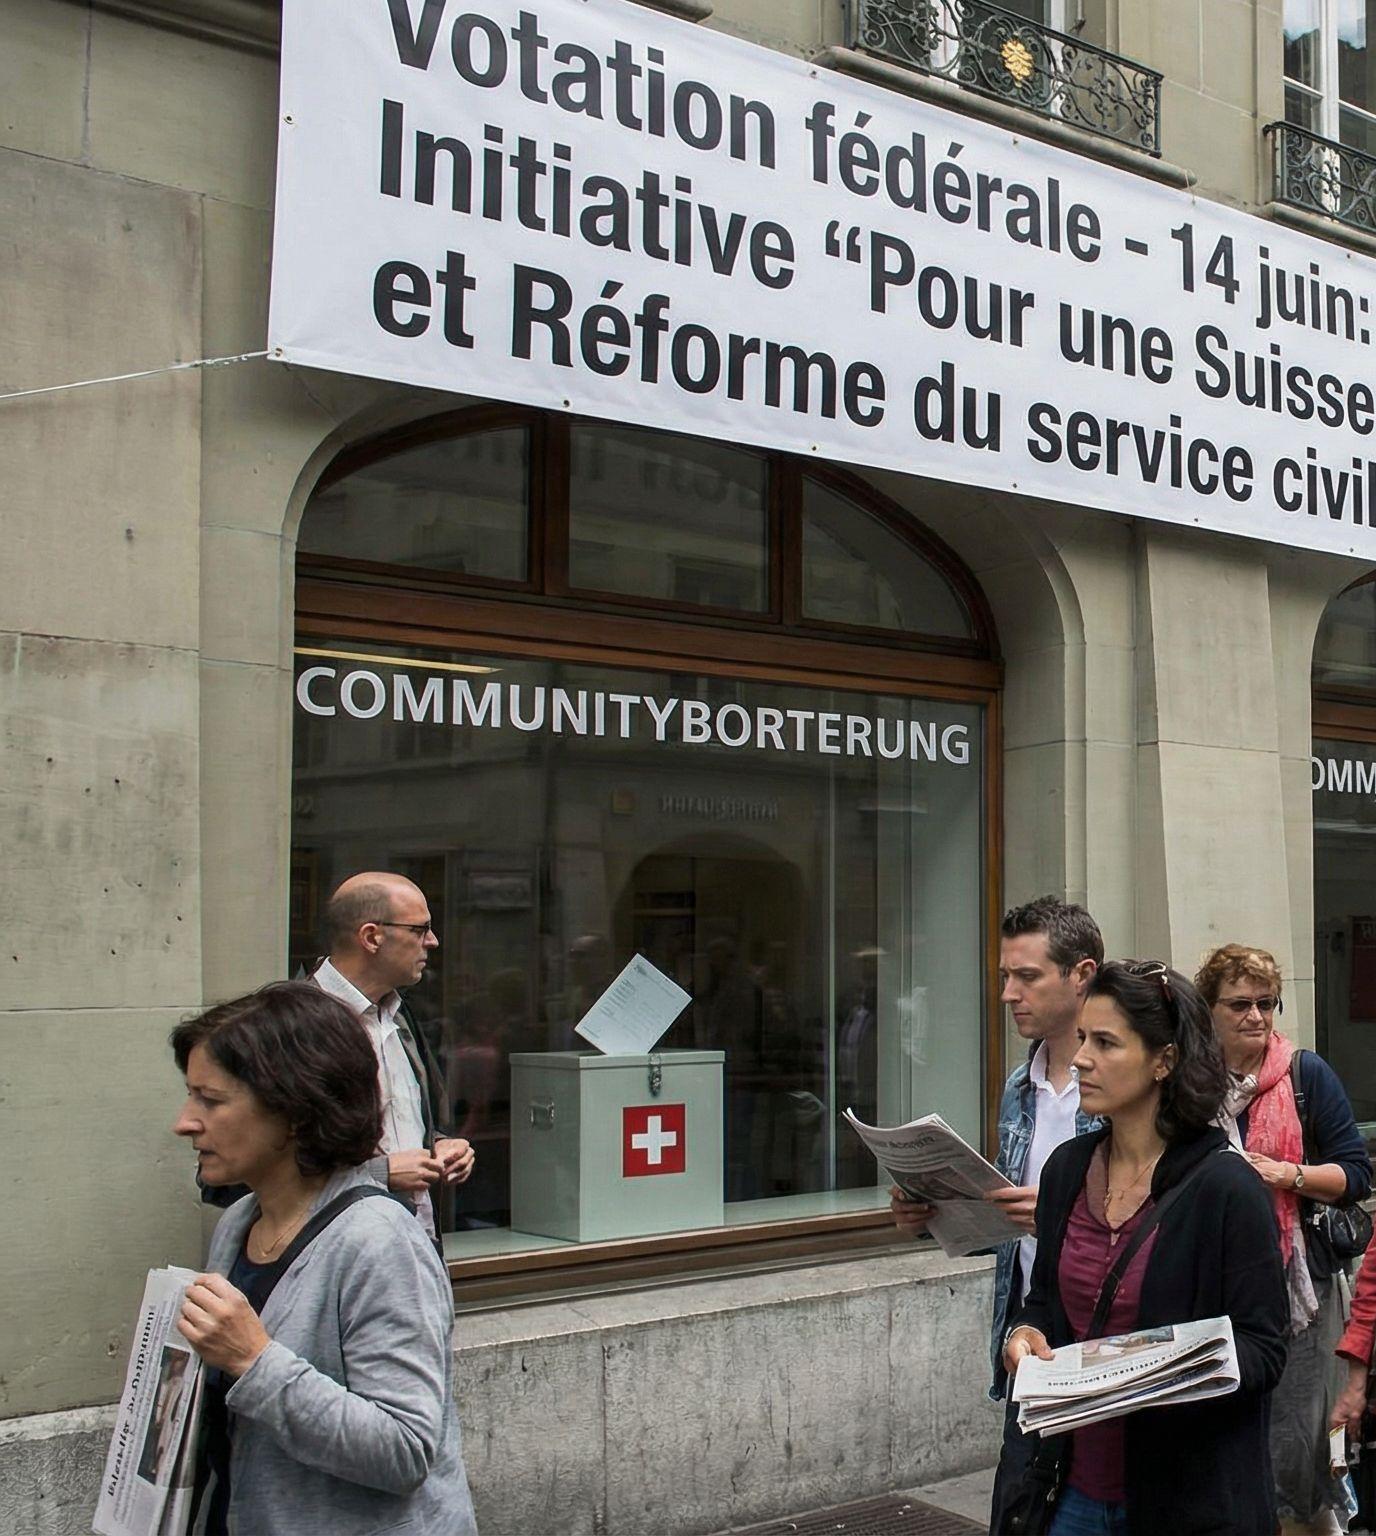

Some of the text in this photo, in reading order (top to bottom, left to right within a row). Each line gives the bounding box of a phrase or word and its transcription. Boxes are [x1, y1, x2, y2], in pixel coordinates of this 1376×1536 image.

[380, 98, 796, 290] Initiative
[825, 220, 1035, 348] “Pour
[1059, 302, 1174, 385] une
[1195, 324, 1375, 436] Suisse
[386, 0, 776, 170] Votation
[805, 101, 1102, 263] fédérale
[1171, 223, 1240, 305] 14
[1255, 246, 1371, 344] juin:
[373, 250, 477, 349] et
[511, 263, 887, 428] Réforme
[914, 360, 1001, 453] du
[1027, 402, 1254, 502] service
[296, 666, 970, 765] COMMUNITYBORTERUNG
